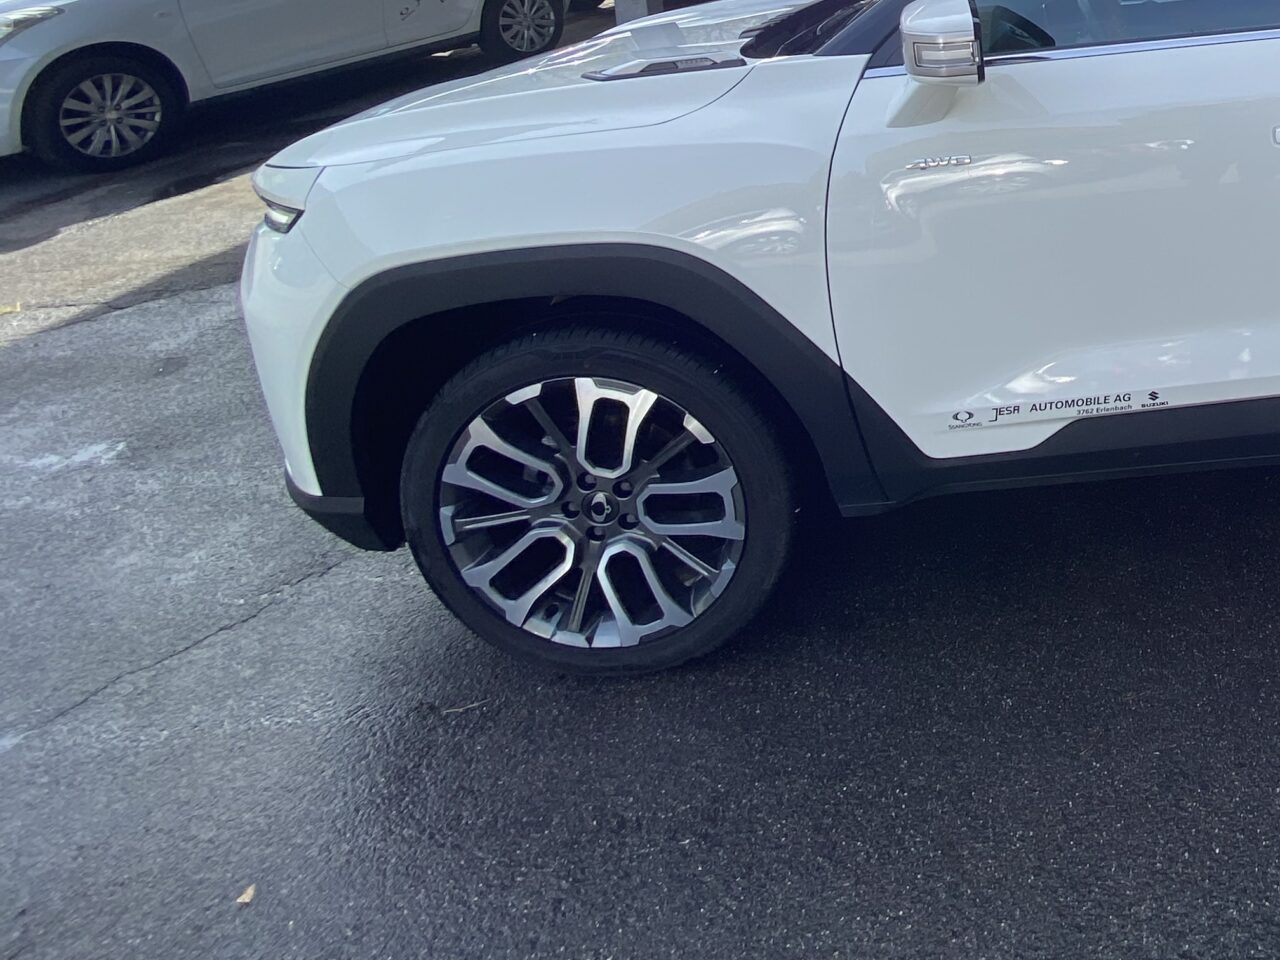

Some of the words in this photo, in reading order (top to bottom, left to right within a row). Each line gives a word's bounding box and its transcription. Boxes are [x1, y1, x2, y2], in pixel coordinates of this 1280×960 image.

[988, 405, 1021, 422] JESA
[1029, 394, 1111, 413] AUTOMOBILE
[1113, 393, 1132, 403] AG
[1096, 404, 1133, 414] Erlenbach
[1141, 400, 1169, 408] SUZUKI
